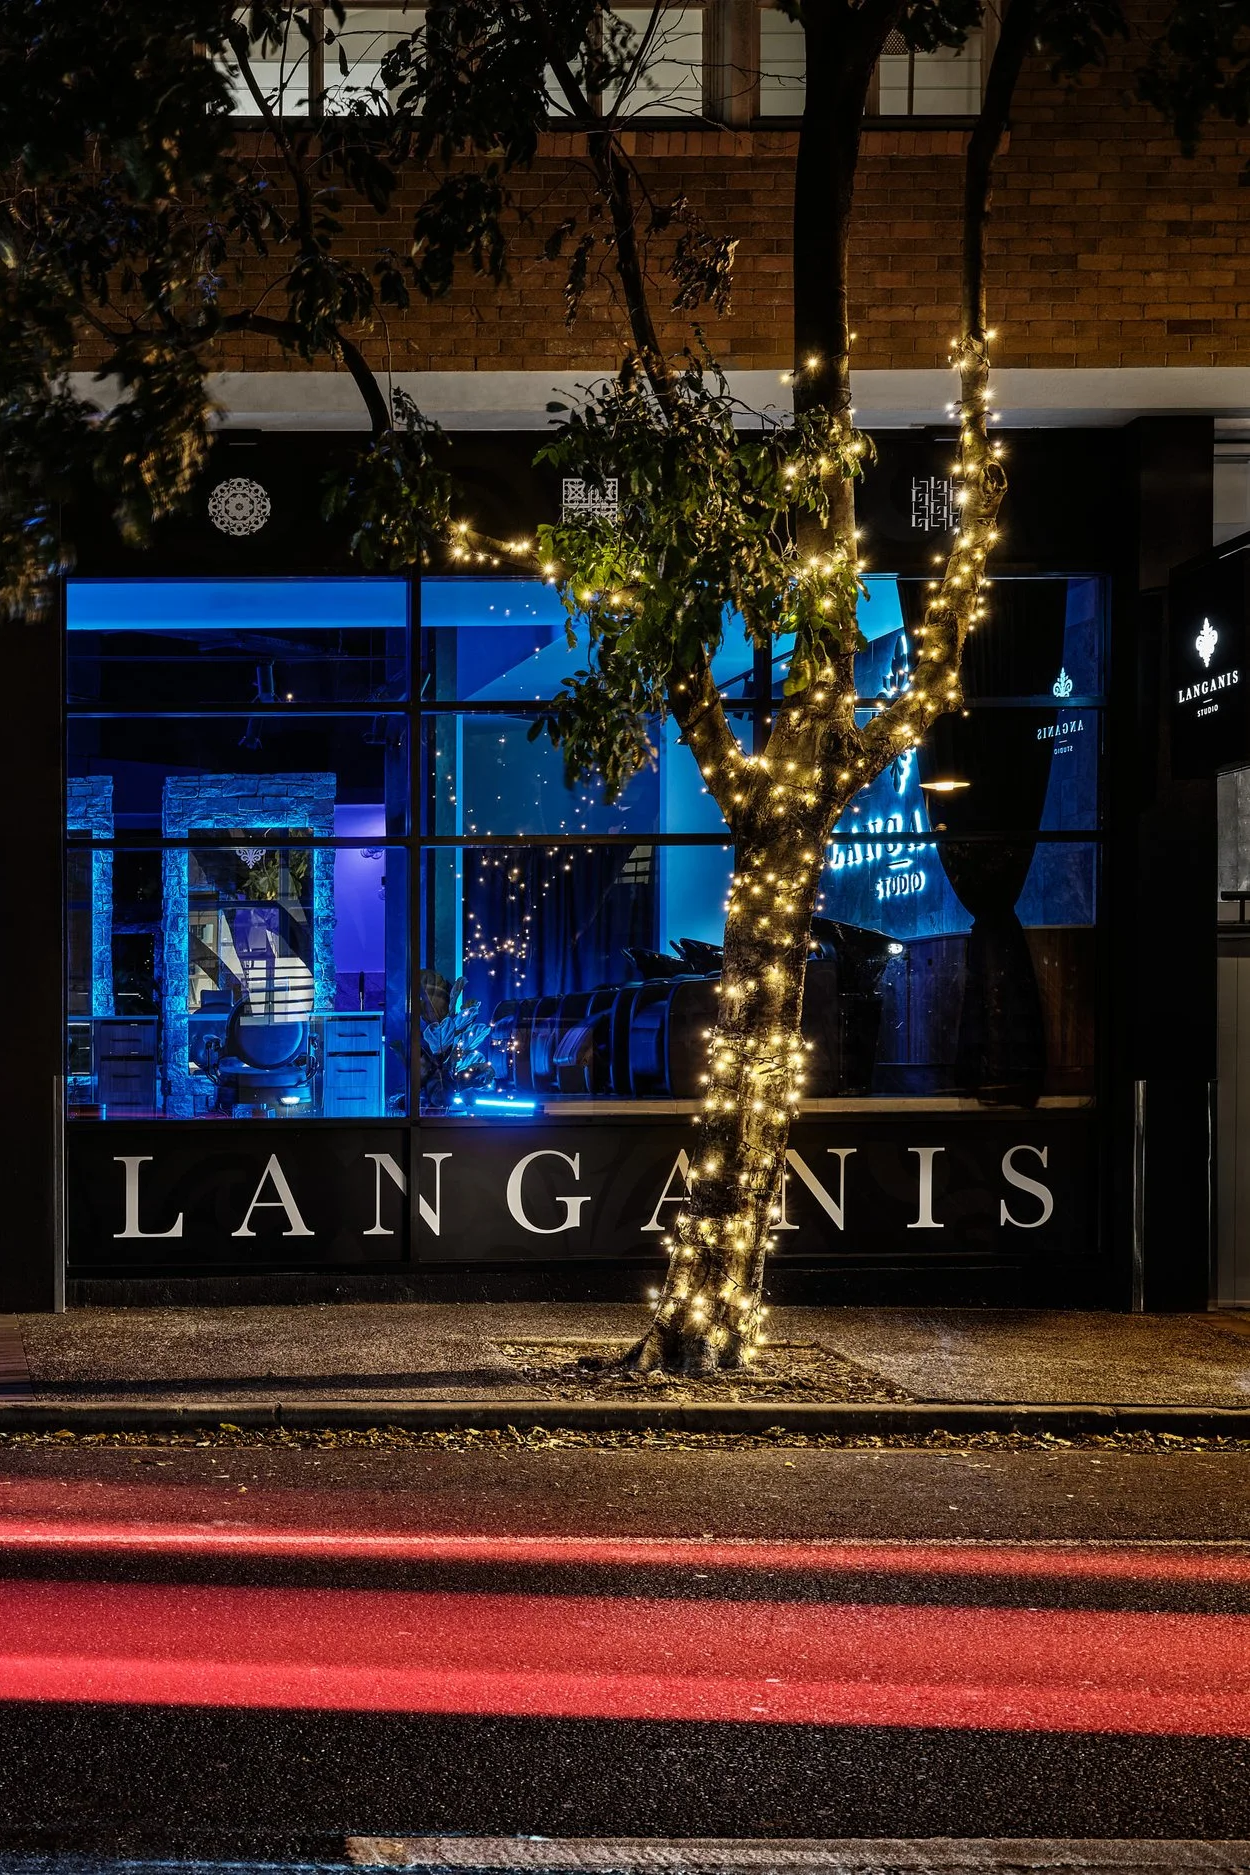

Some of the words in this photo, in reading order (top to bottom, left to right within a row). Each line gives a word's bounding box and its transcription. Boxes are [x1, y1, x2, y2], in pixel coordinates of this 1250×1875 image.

[1178, 669, 1239, 704] LANGANIS
[1197, 703, 1219, 718] STUDIO
[874, 871, 925, 899] STUDIO
